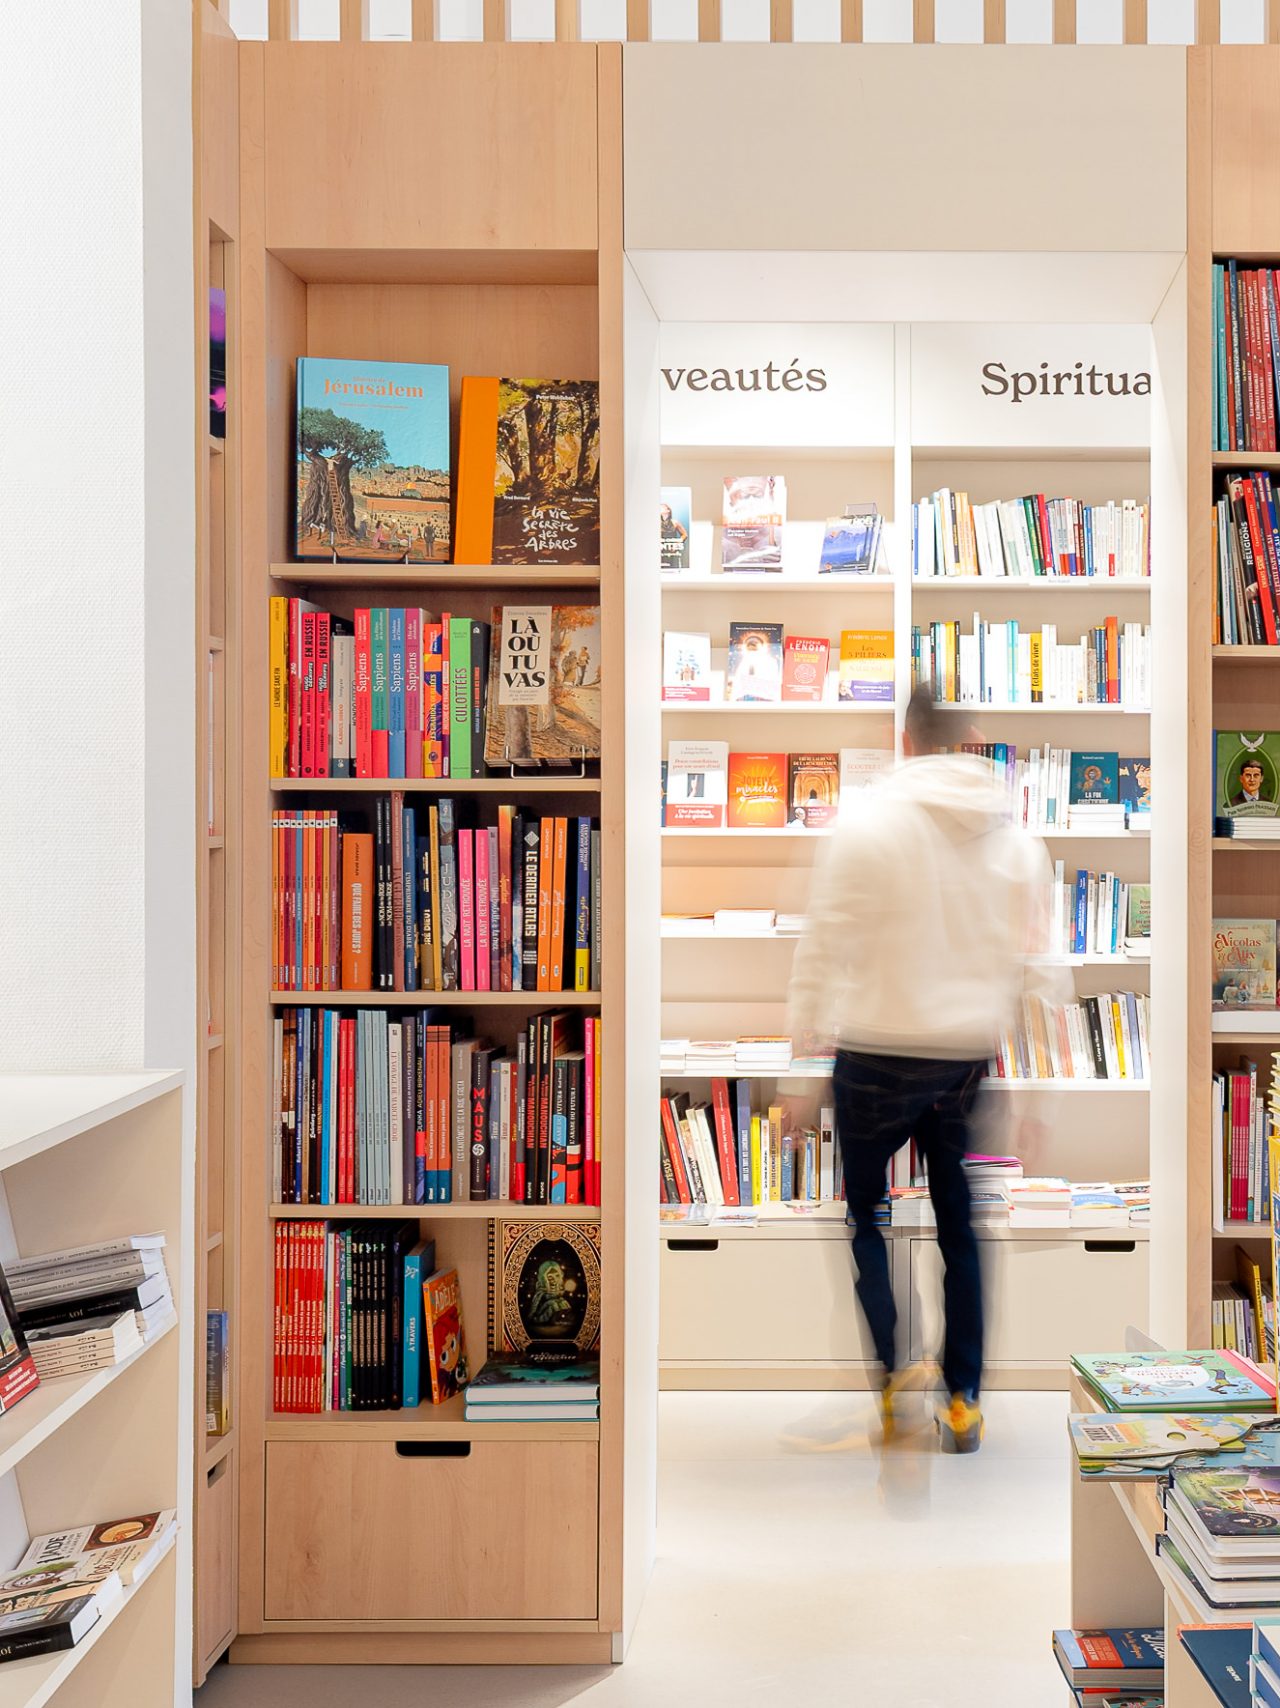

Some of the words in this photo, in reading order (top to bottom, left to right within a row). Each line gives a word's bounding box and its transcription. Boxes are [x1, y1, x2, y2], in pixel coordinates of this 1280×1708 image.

[660, 358, 828, 393] veautés
[980, 361, 1152, 404] Spiritua
[324, 378, 423, 398] Jérusalem
[1242, 522, 1254, 566] RELIGIONS
[305, 618, 313, 645] RUSSIE
[319, 620, 328, 646] RUSSIE
[511, 616, 540, 634] LÀ
[508, 633, 541, 652] OÙ
[789, 643, 826, 652] LENOIR
[305, 648, 313, 658] EN
[319, 649, 328, 659] EN
[509, 655, 539, 670] TU
[357, 652, 368, 692] Sapiens
[373, 652, 385, 692] Sapiens
[390, 653, 403, 693] Sapiens
[406, 652, 418, 692] Sapiens
[503, 671, 546, 688] VAS
[525, 851, 538, 862] LE
[525, 865, 538, 905] DERNIER
[463, 917, 472, 936] NUIT
[479, 917, 487, 936] NUIT
[525, 907, 538, 937] ATLAS
[463, 938, 471, 948] LA
[479, 938, 487, 948] LA
[1215, 931, 1262, 949] Nicolas
[472, 1088, 485, 1142] MAUS
[527, 1098, 535, 1149] MANOUCHIAN
